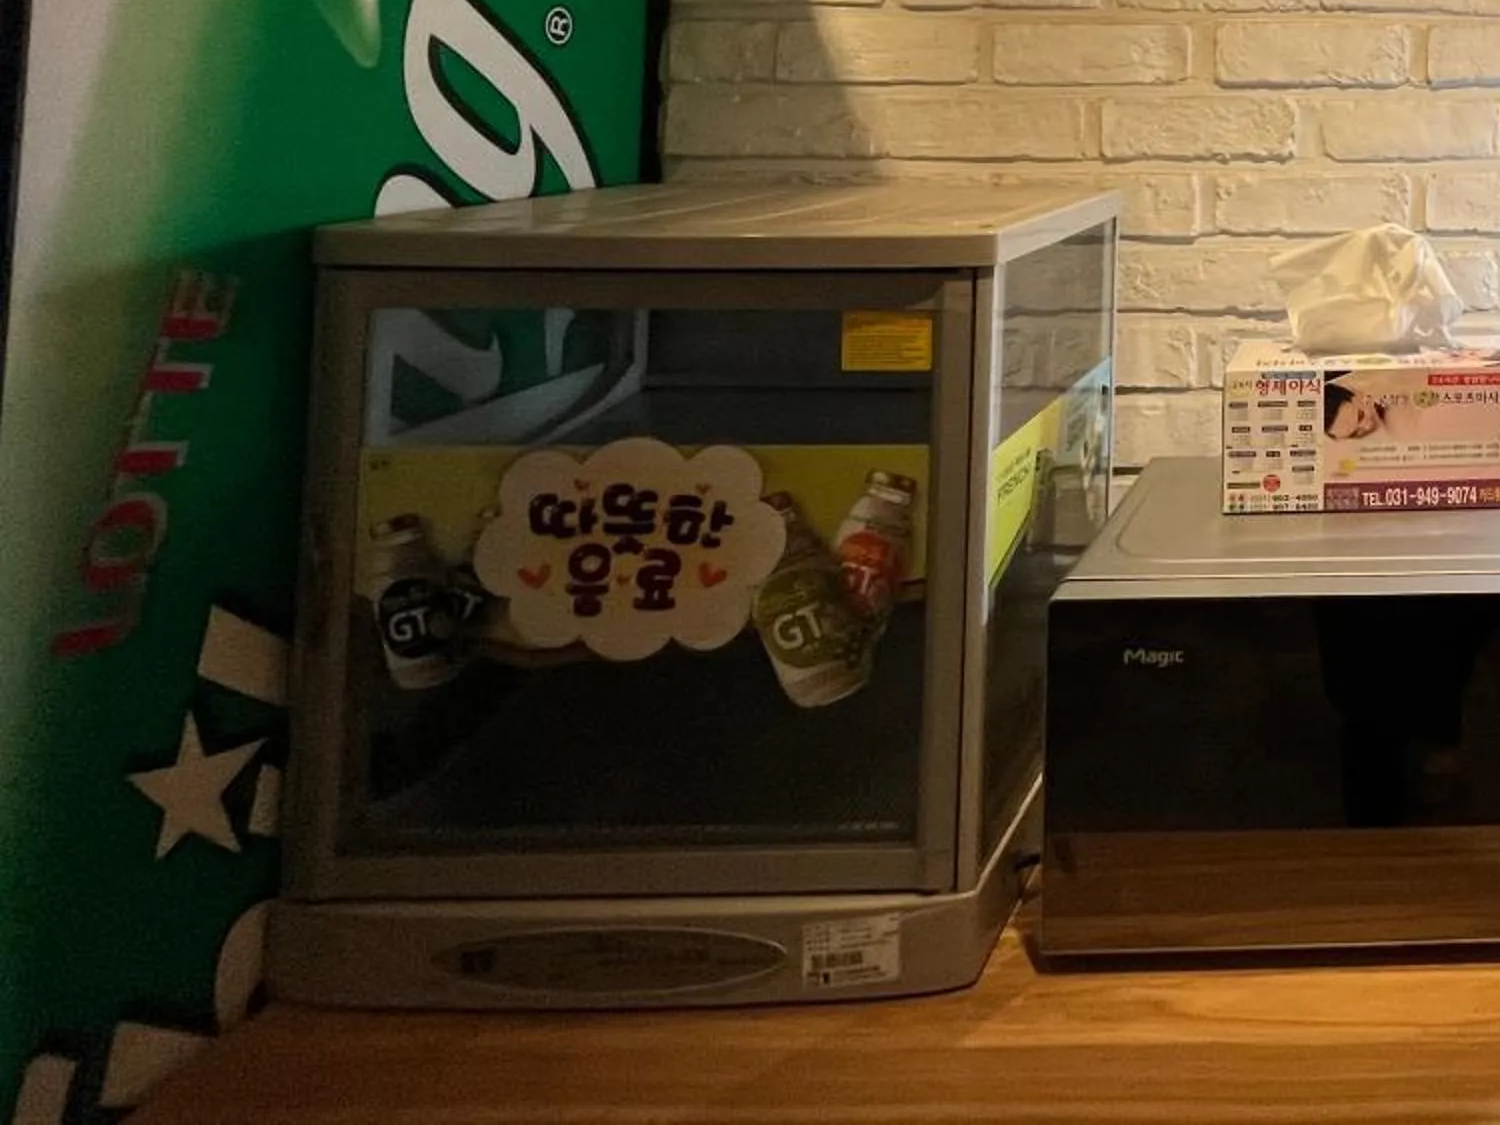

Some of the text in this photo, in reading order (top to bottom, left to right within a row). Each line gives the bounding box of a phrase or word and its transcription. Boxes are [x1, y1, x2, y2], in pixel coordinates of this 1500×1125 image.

[529, 482, 735, 555] 따뜻한
[564, 542, 682, 617] 음료
[388, 603, 432, 642] GT
[772, 601, 824, 651] GT
[1123, 647, 1185, 668] Magic
